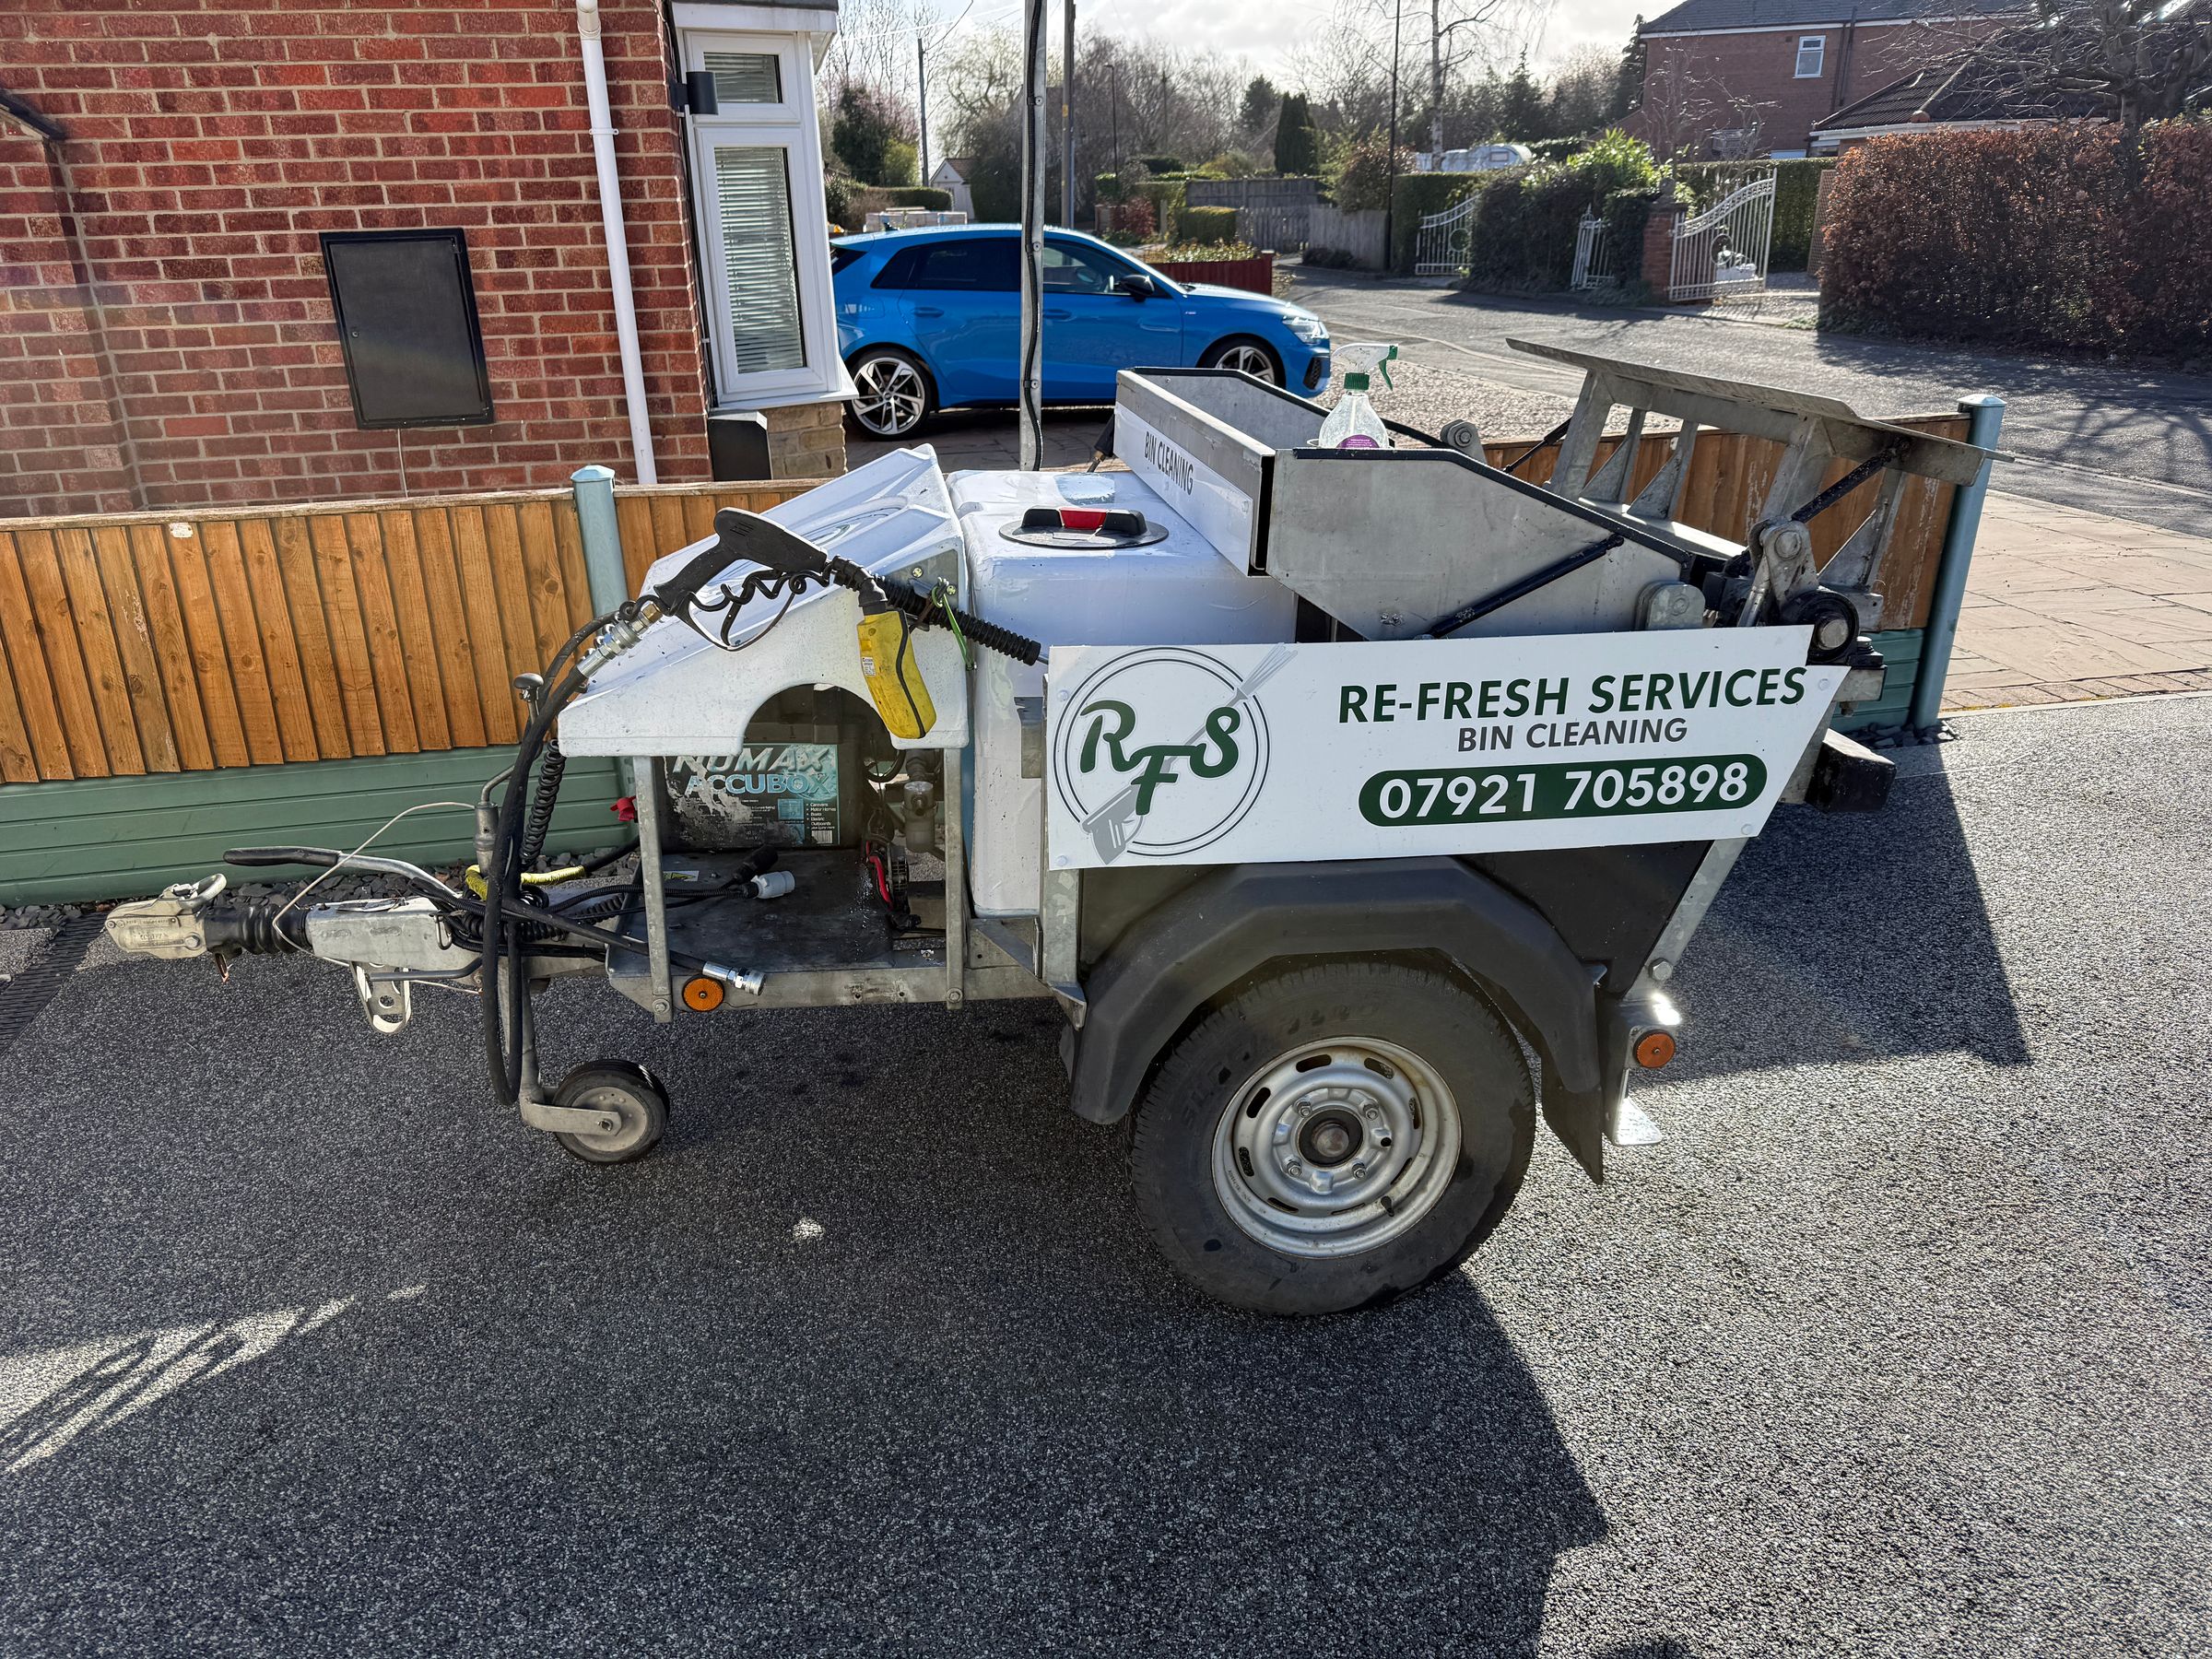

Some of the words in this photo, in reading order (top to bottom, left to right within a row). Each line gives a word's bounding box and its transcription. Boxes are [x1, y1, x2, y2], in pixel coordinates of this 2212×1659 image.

[1144, 430, 1157, 465] BIN
[1157, 441, 1194, 496] CLEANING
[1338, 677, 1570, 724] RE-FRESH
[1587, 666, 1807, 714] SERVICES
[672, 747, 830, 773] NUMAX
[1079, 700, 1241, 816] RFS
[1457, 724, 1513, 752] BIN
[1525, 717, 1688, 748] CLEANING
[684, 773, 830, 794] ACCUBOX
[1379, 773, 1536, 818] 07921
[1563, 762, 1748, 810] 705898
